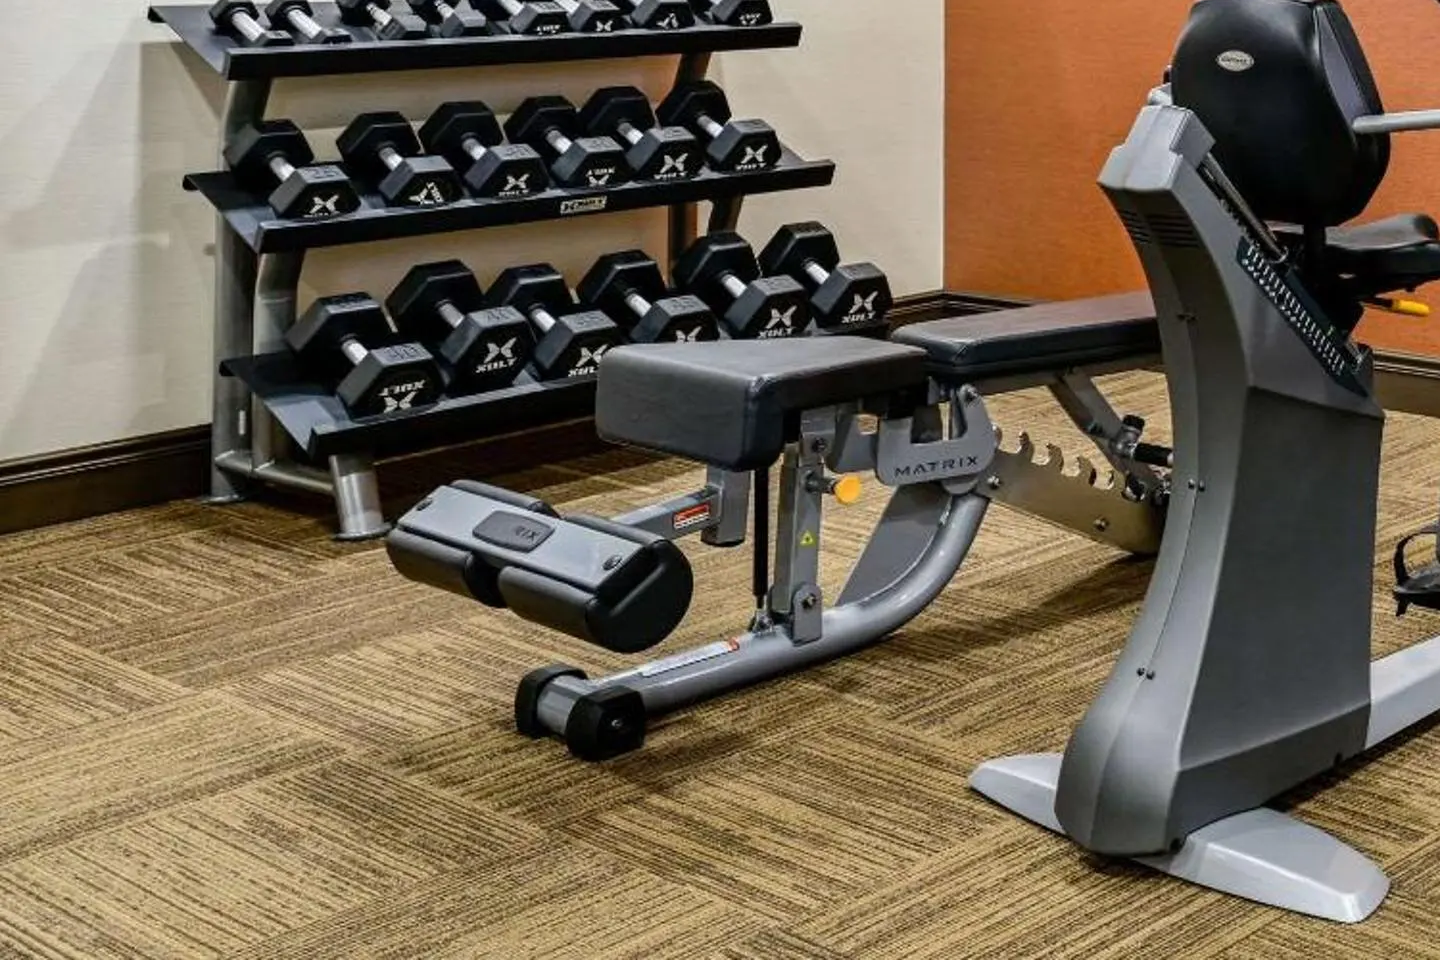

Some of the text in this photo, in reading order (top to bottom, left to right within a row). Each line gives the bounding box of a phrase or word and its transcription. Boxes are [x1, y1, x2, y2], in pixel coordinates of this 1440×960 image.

[840, 311, 876, 324] XULT
[758, 326, 795, 340] XULT
[475, 357, 516, 374] XULT
[567, 364, 600, 377] XUL
[378, 378, 426, 397] XULT
[893, 455, 979, 478] MATRIX
